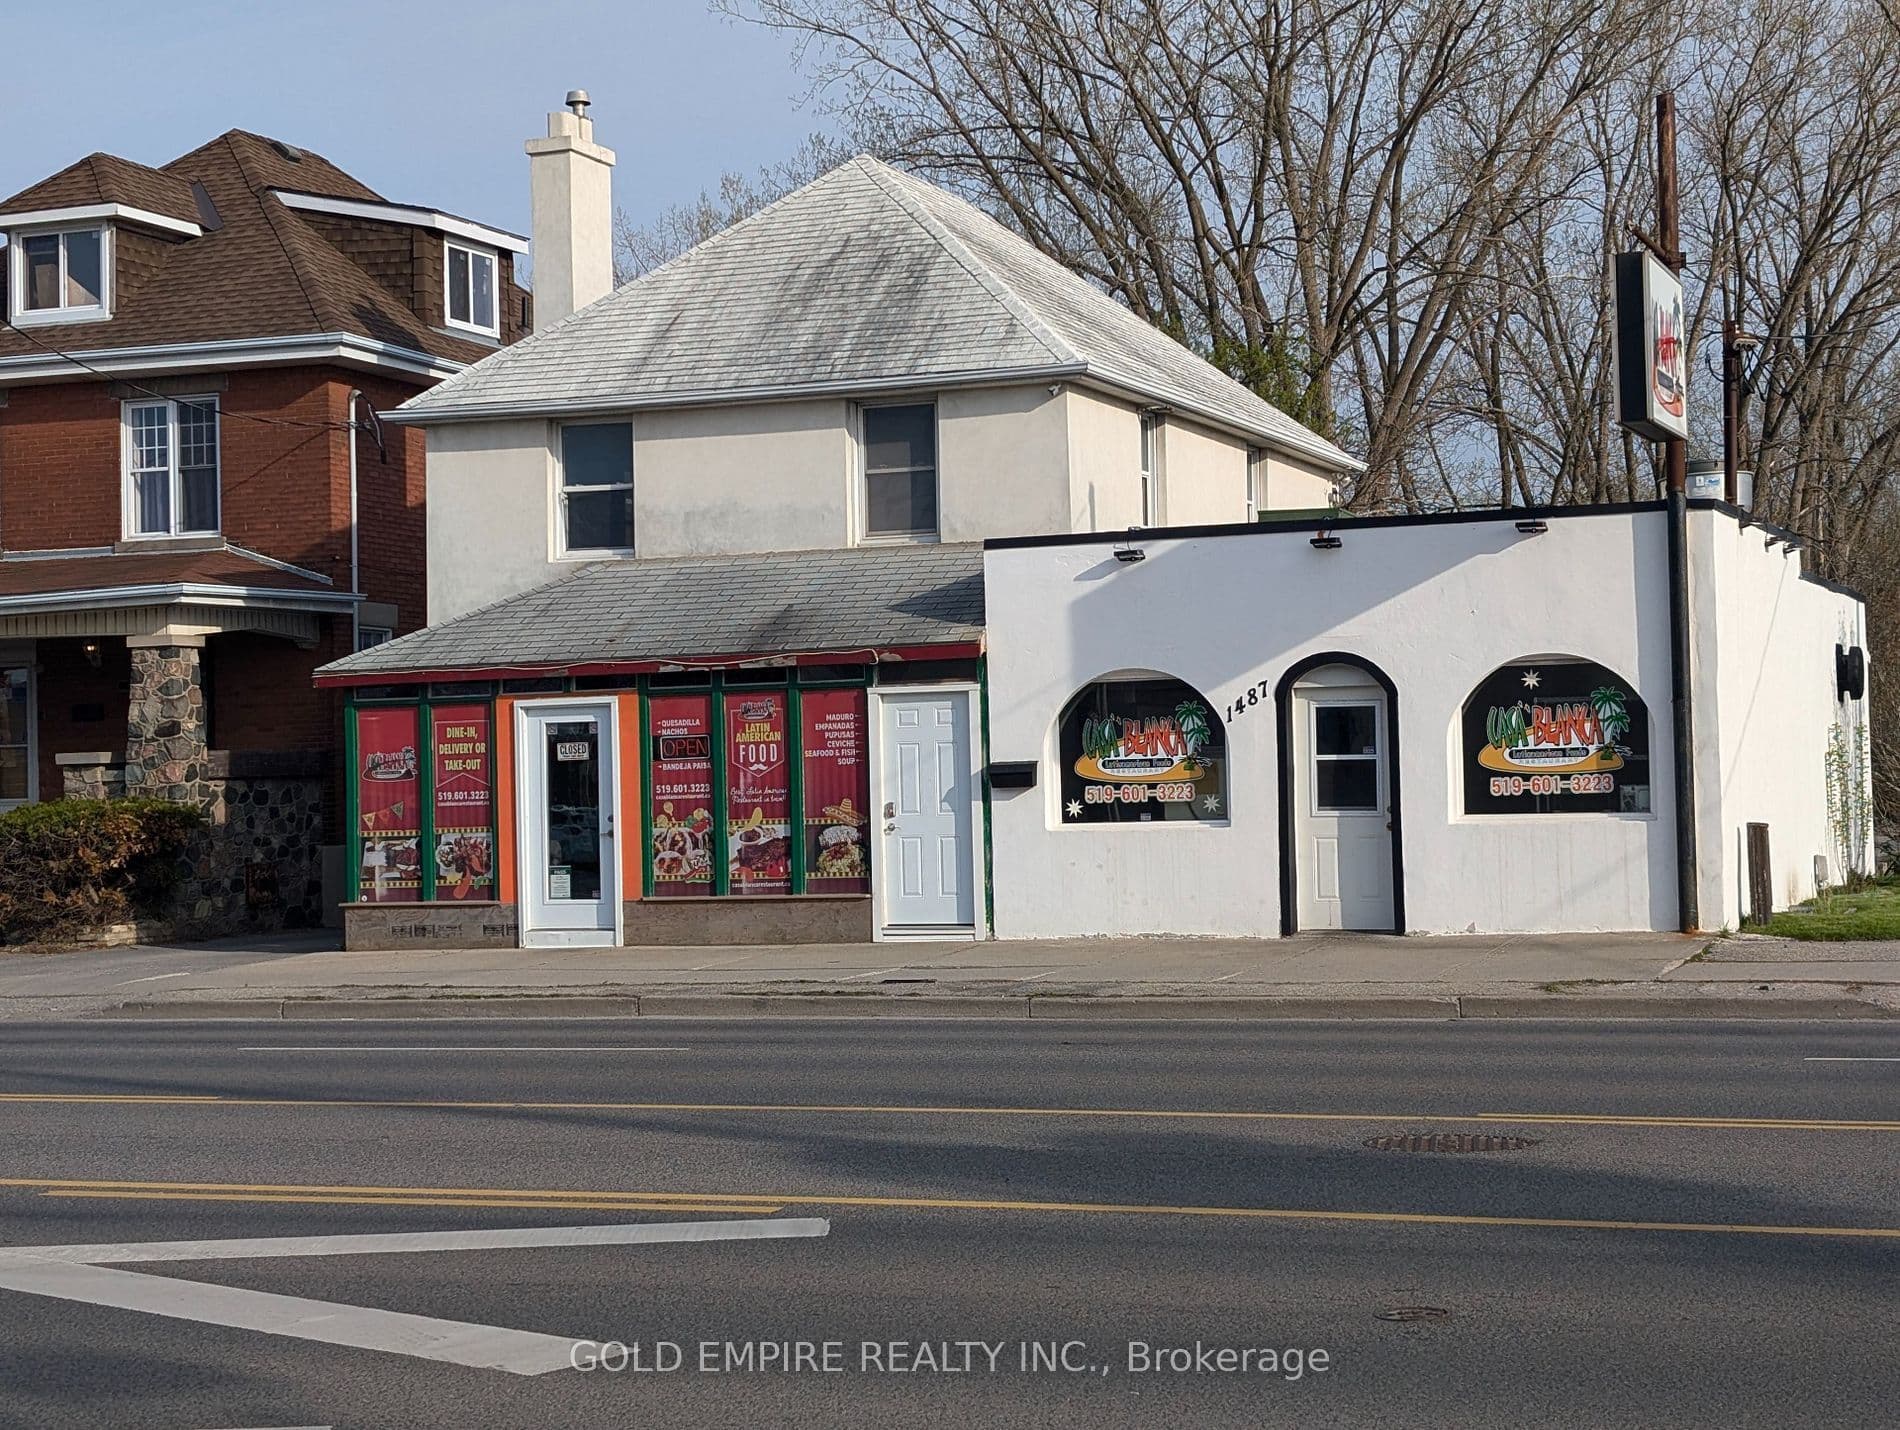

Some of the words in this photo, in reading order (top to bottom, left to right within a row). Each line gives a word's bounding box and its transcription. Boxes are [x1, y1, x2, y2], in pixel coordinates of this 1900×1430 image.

[1226, 679, 1268, 723] 1487
[826, 713, 854, 721] MADURO
[661, 719, 700, 727] QUESADILLA
[745, 722, 770, 733] LATIN
[815, 722, 855, 730] EMPANADAS
[1486, 706, 1530, 749] CASA
[1531, 703, 1605, 746] BLANCA
[446, 726, 478, 739] DINE-IN,
[736, 731, 781, 742] AMERICAN
[825, 731, 855, 739] PUPUSAS
[1082, 718, 1121, 760] CASA
[1123, 716, 1188, 758] BLANCA
[439, 743, 474, 755] DELIVERY
[475, 742, 486, 753] OR
[560, 744, 587, 755] CLOSED
[663, 738, 708, 756] OPEN
[804, 749, 834, 757] SEAFOOD
[841, 748, 856, 756] FISH
[740, 744, 777, 763] FOOD
[444, 759, 481, 771] TAKE-OUT
[837, 757, 856, 765] SOUP
[662, 763, 692, 771] BANDEJA
[656, 783, 710, 793] 519.601.3223
[1491, 773, 1614, 796] 519-601-3223
[438, 790, 489, 801] 519.601.3223
[1085, 783, 1195, 804] 519-601-3223
